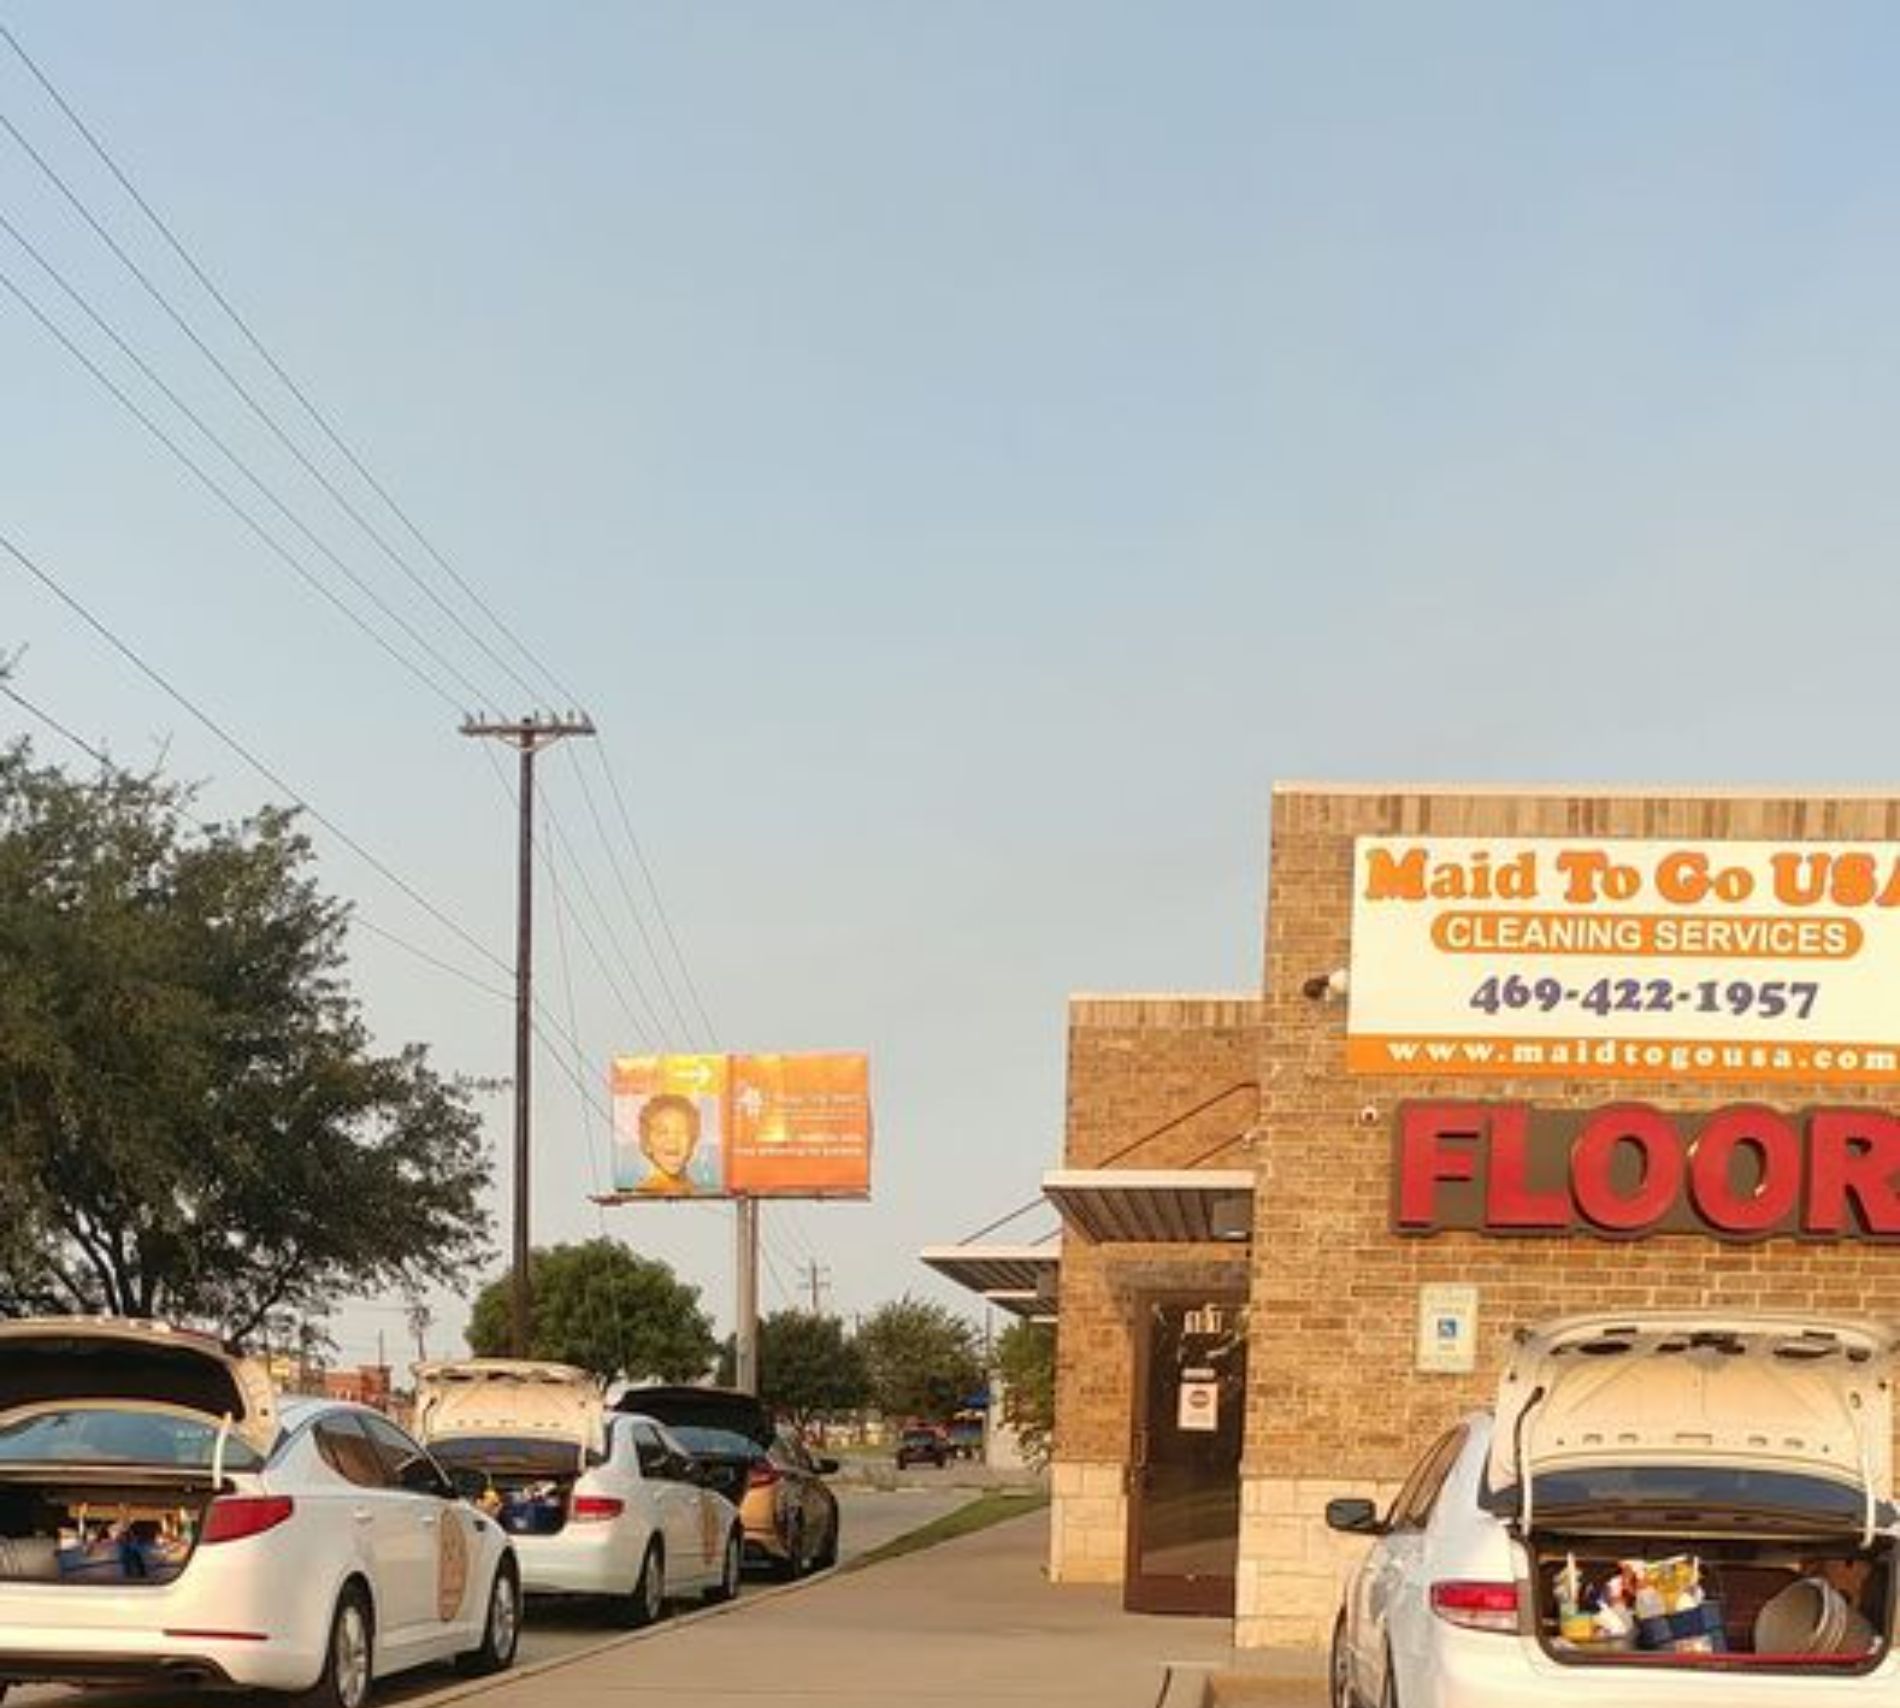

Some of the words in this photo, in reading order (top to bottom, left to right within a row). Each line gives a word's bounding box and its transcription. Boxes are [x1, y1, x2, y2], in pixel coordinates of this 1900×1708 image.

[1365, 847, 1538, 900] Maid
[1556, 850, 1641, 904] To
[1655, 851, 1755, 905] Go
[1446, 916, 1642, 950] CLEANING
[1654, 920, 1848, 954] SERVICES
[1469, 974, 1820, 1019] 469-422-1957
[1386, 1038, 1897, 1071] www.maidtogousa.com
[1397, 1099, 1900, 1240] FLOOR
